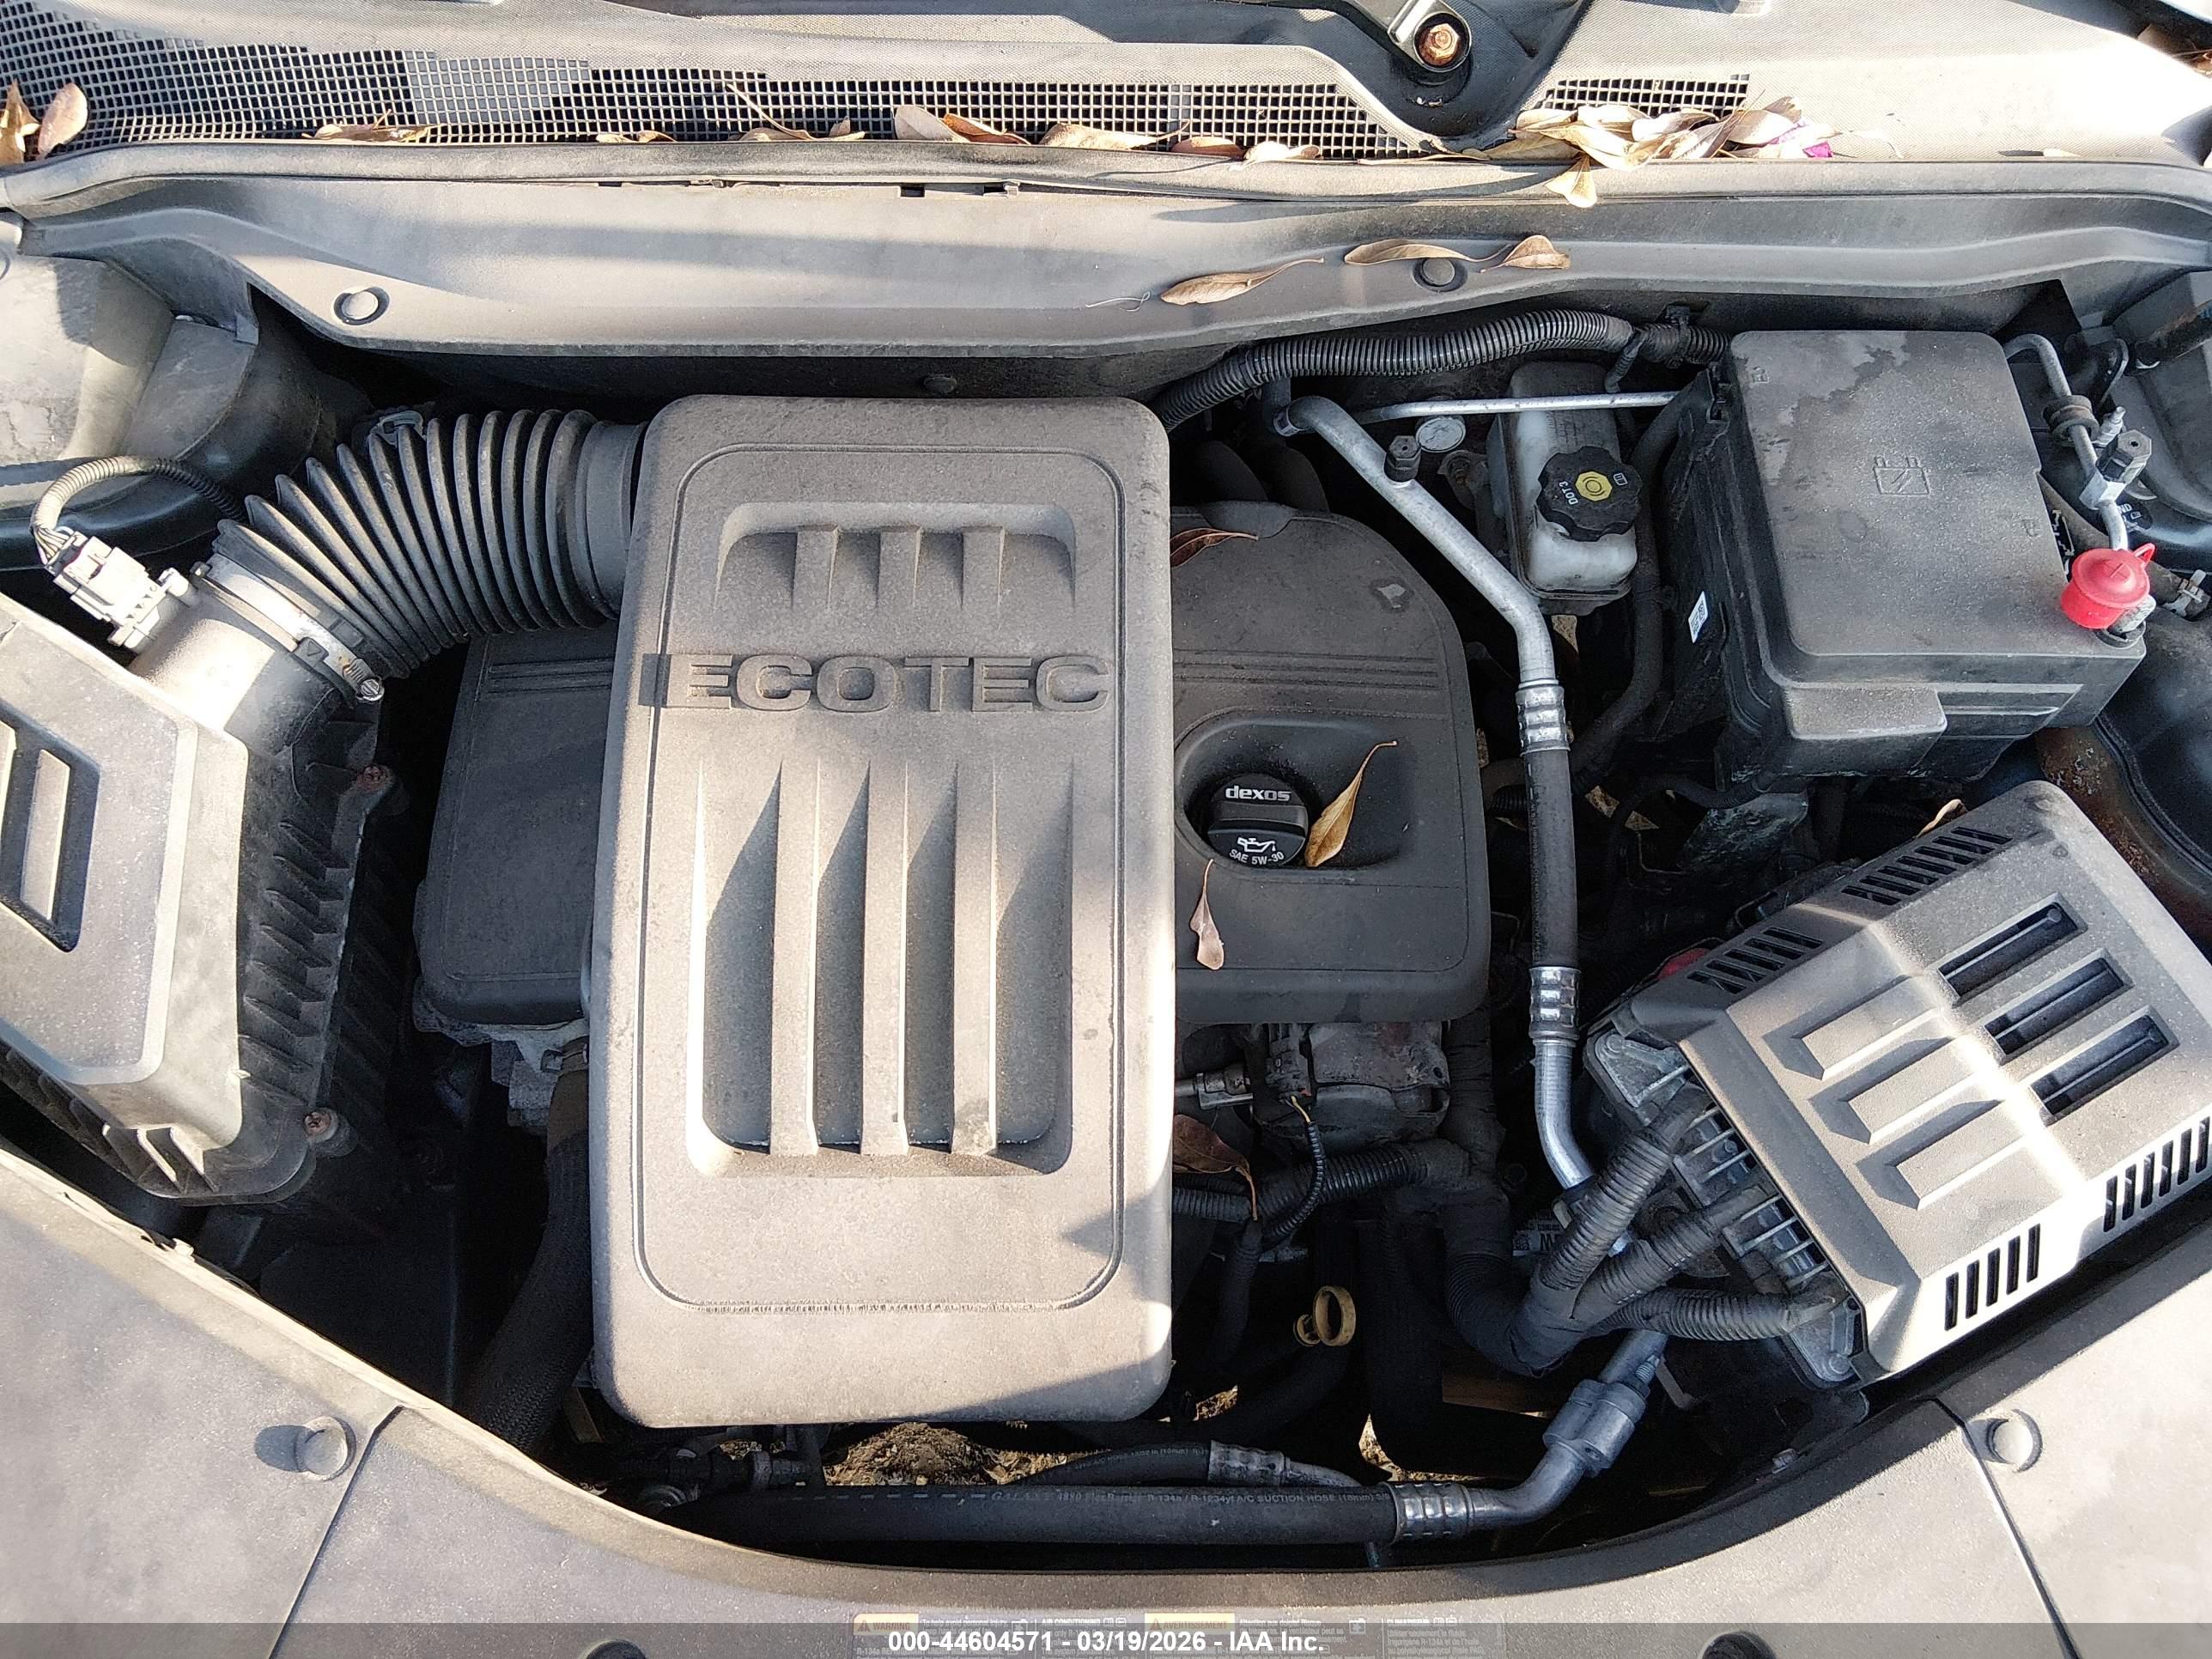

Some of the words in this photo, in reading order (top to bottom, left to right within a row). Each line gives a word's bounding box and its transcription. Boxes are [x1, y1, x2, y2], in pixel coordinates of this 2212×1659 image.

[666, 653, 1110, 713] ECOTEC
[1225, 785, 1292, 802] dexos
[1229, 848, 1248, 864] SAE
[1251, 851, 1285, 865] 5W-30
[872, 1621, 911, 1631] WARNING
[1163, 1620, 1228, 1630] AVERTISSEMENT
